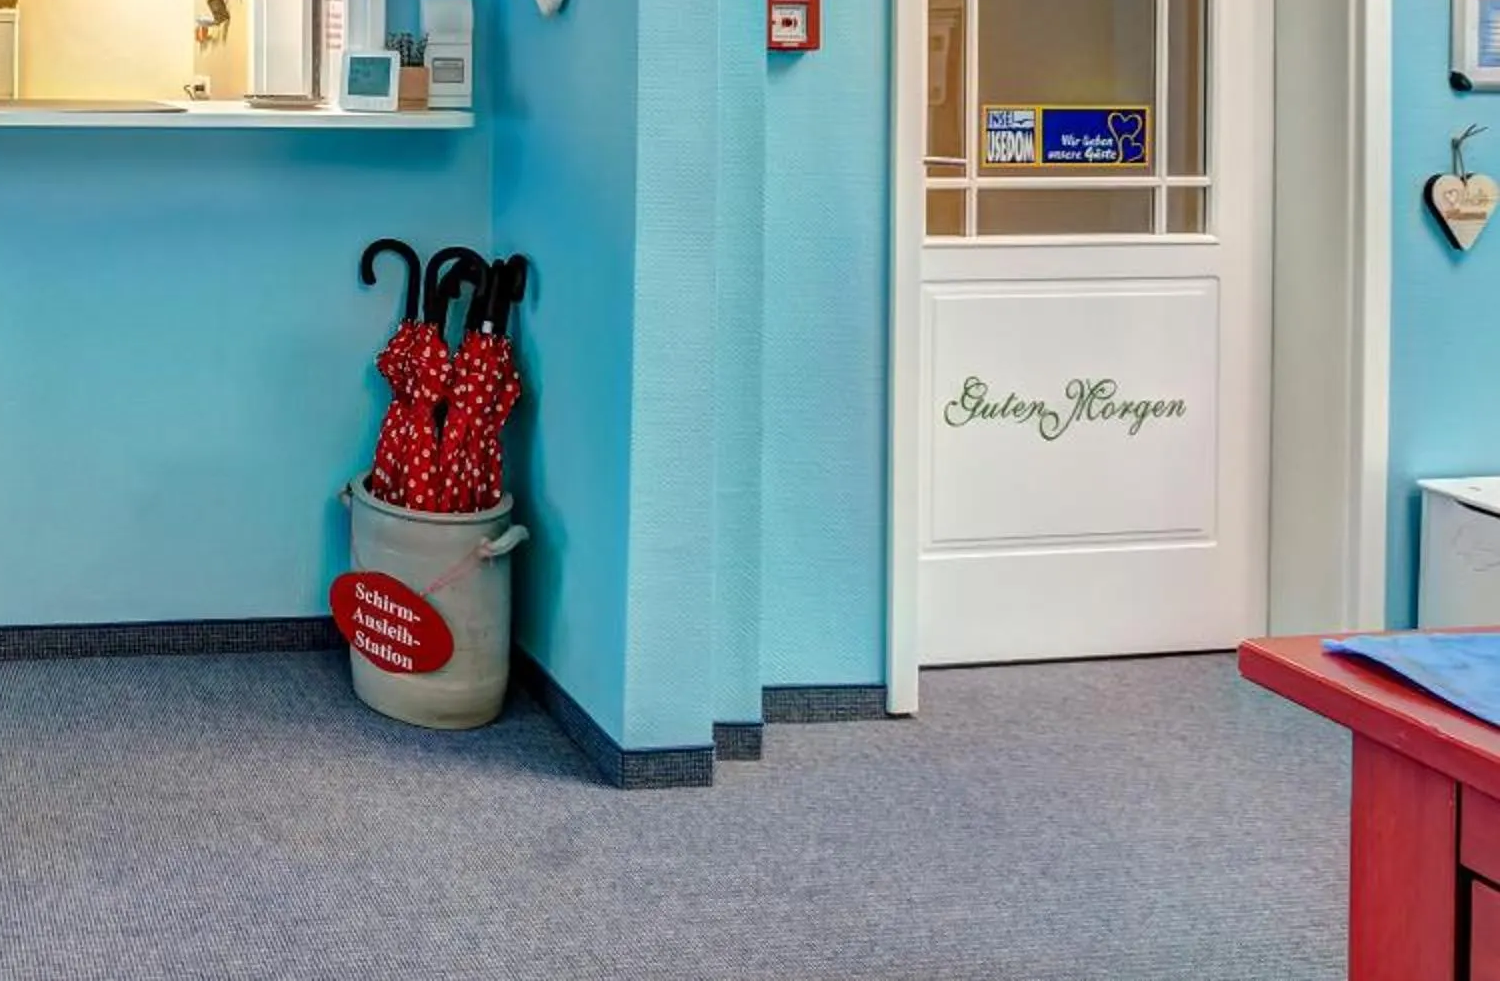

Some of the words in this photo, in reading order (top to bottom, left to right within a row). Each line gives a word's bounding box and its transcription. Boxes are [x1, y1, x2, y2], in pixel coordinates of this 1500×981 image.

[988, 130, 1034, 162] USEDOM
[944, 376, 1045, 427] Guten
[1039, 379, 1187, 441] Morgen
[355, 582, 421, 623] Schirm-
[352, 606, 421, 647] Ausleih-
[355, 630, 414, 671] Station
